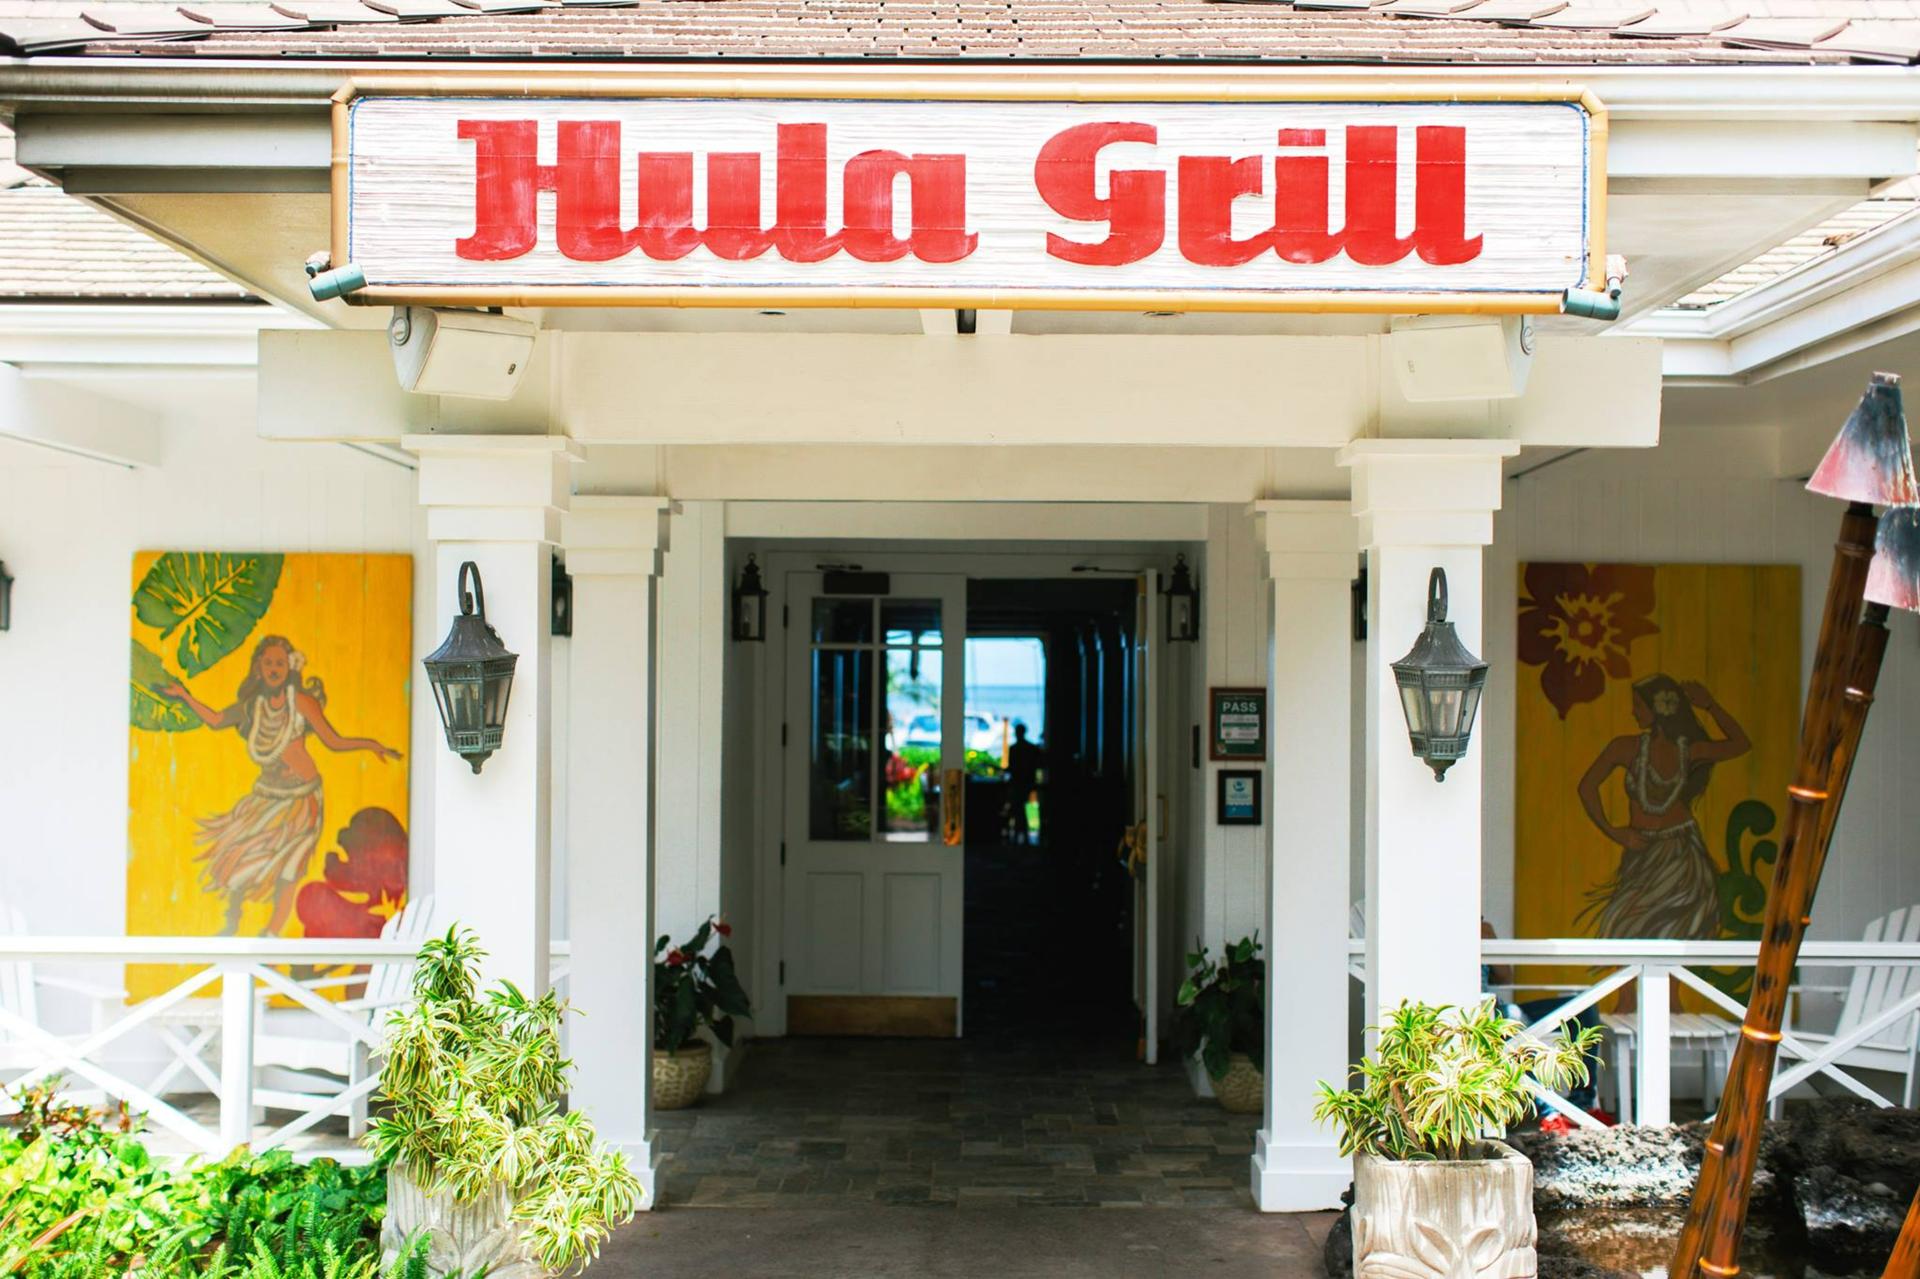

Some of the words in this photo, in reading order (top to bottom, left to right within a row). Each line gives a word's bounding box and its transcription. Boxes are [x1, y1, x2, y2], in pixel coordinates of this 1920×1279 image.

[456, 120, 979, 262] Hula
[1034, 121, 1483, 266] Grill
[1222, 701, 1258, 713] PASS
